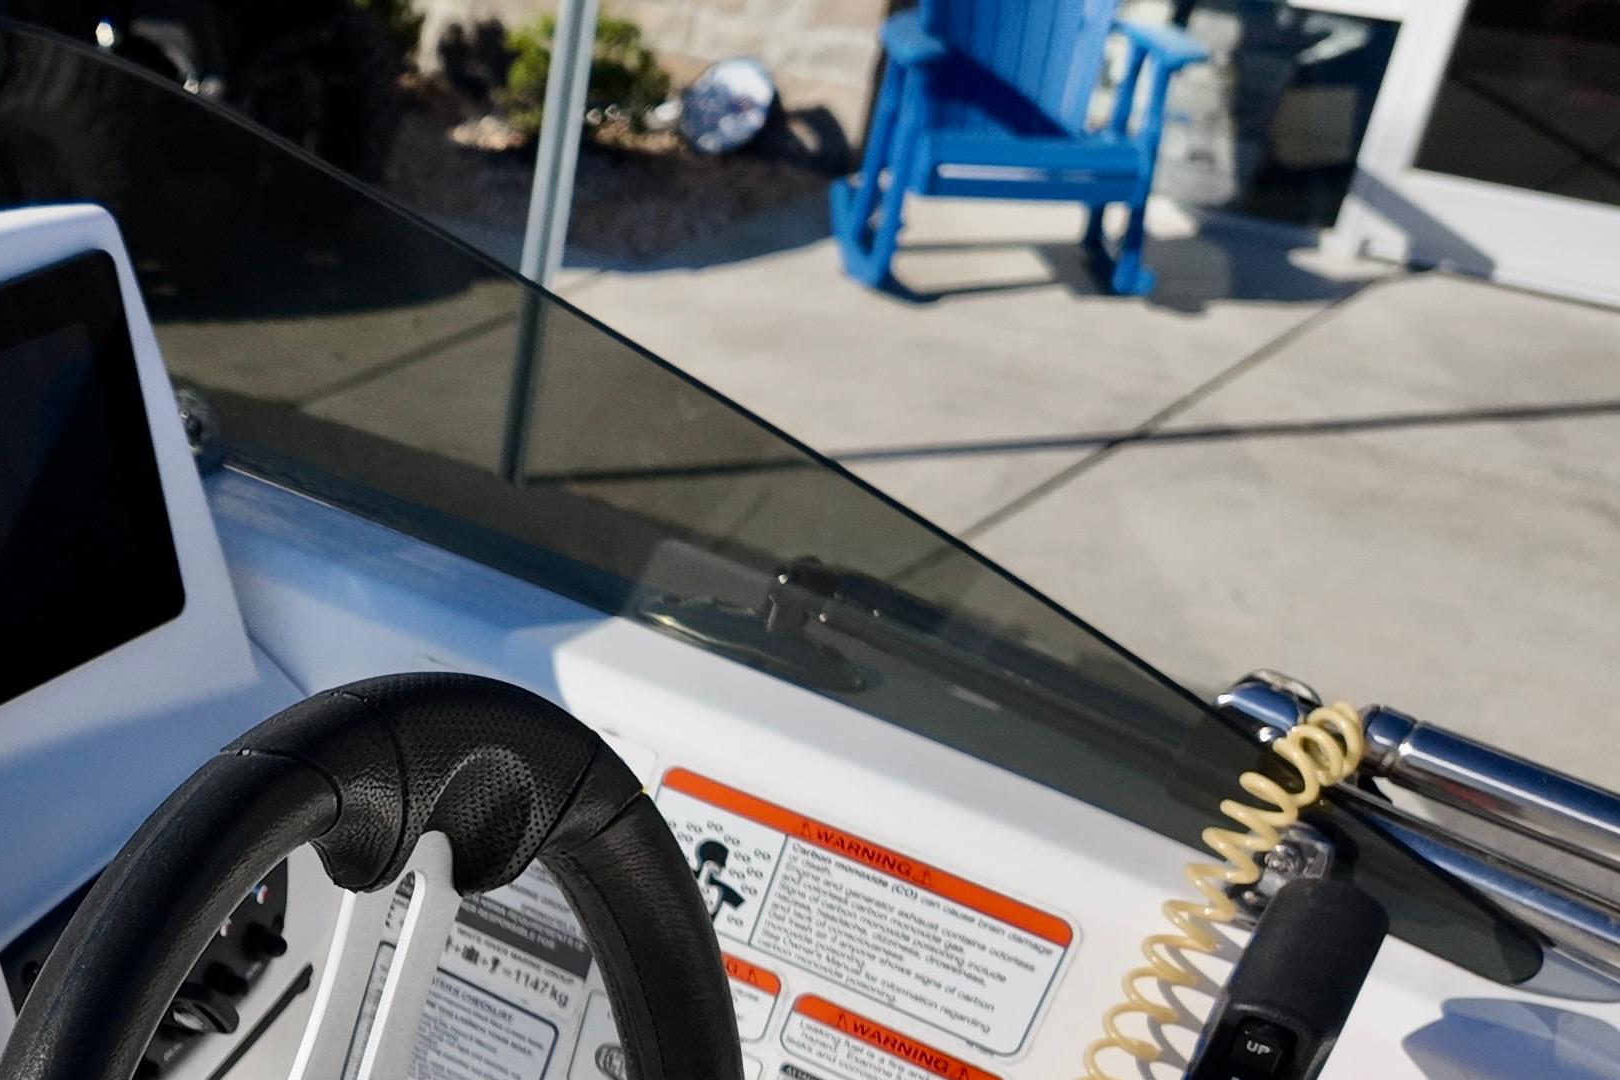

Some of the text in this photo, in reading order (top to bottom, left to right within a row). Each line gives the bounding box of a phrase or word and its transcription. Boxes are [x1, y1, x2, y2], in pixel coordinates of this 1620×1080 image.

[816, 830, 912, 875] WARNING
[784, 862, 1036, 971] Engine and generator exhaust contains odorless
[792, 843, 1054, 956] Carbon monoxide (CO) can cause brain damage
[851, 902, 887, 920] carbon
[890, 919, 941, 942] monoxide
[822, 900, 857, 918] carbon
[860, 916, 911, 941] monoxide
[912, 939, 965, 967] poisoning
[968, 962, 1007, 982] include
[515, 969, 570, 1009] 1147 kg
[839, 941, 876, 960] anyone
[879, 957, 912, 975] shows
[914, 973, 942, 989] signs
[958, 991, 995, 1011] carbon
[925, 956, 988, 986] drowsiness,
[880, 980, 938, 1008] information
[940, 1006, 992, 1032] regarding
[851, 1021, 950, 1072] WARNING
[1246, 1040, 1270, 1055] UP
